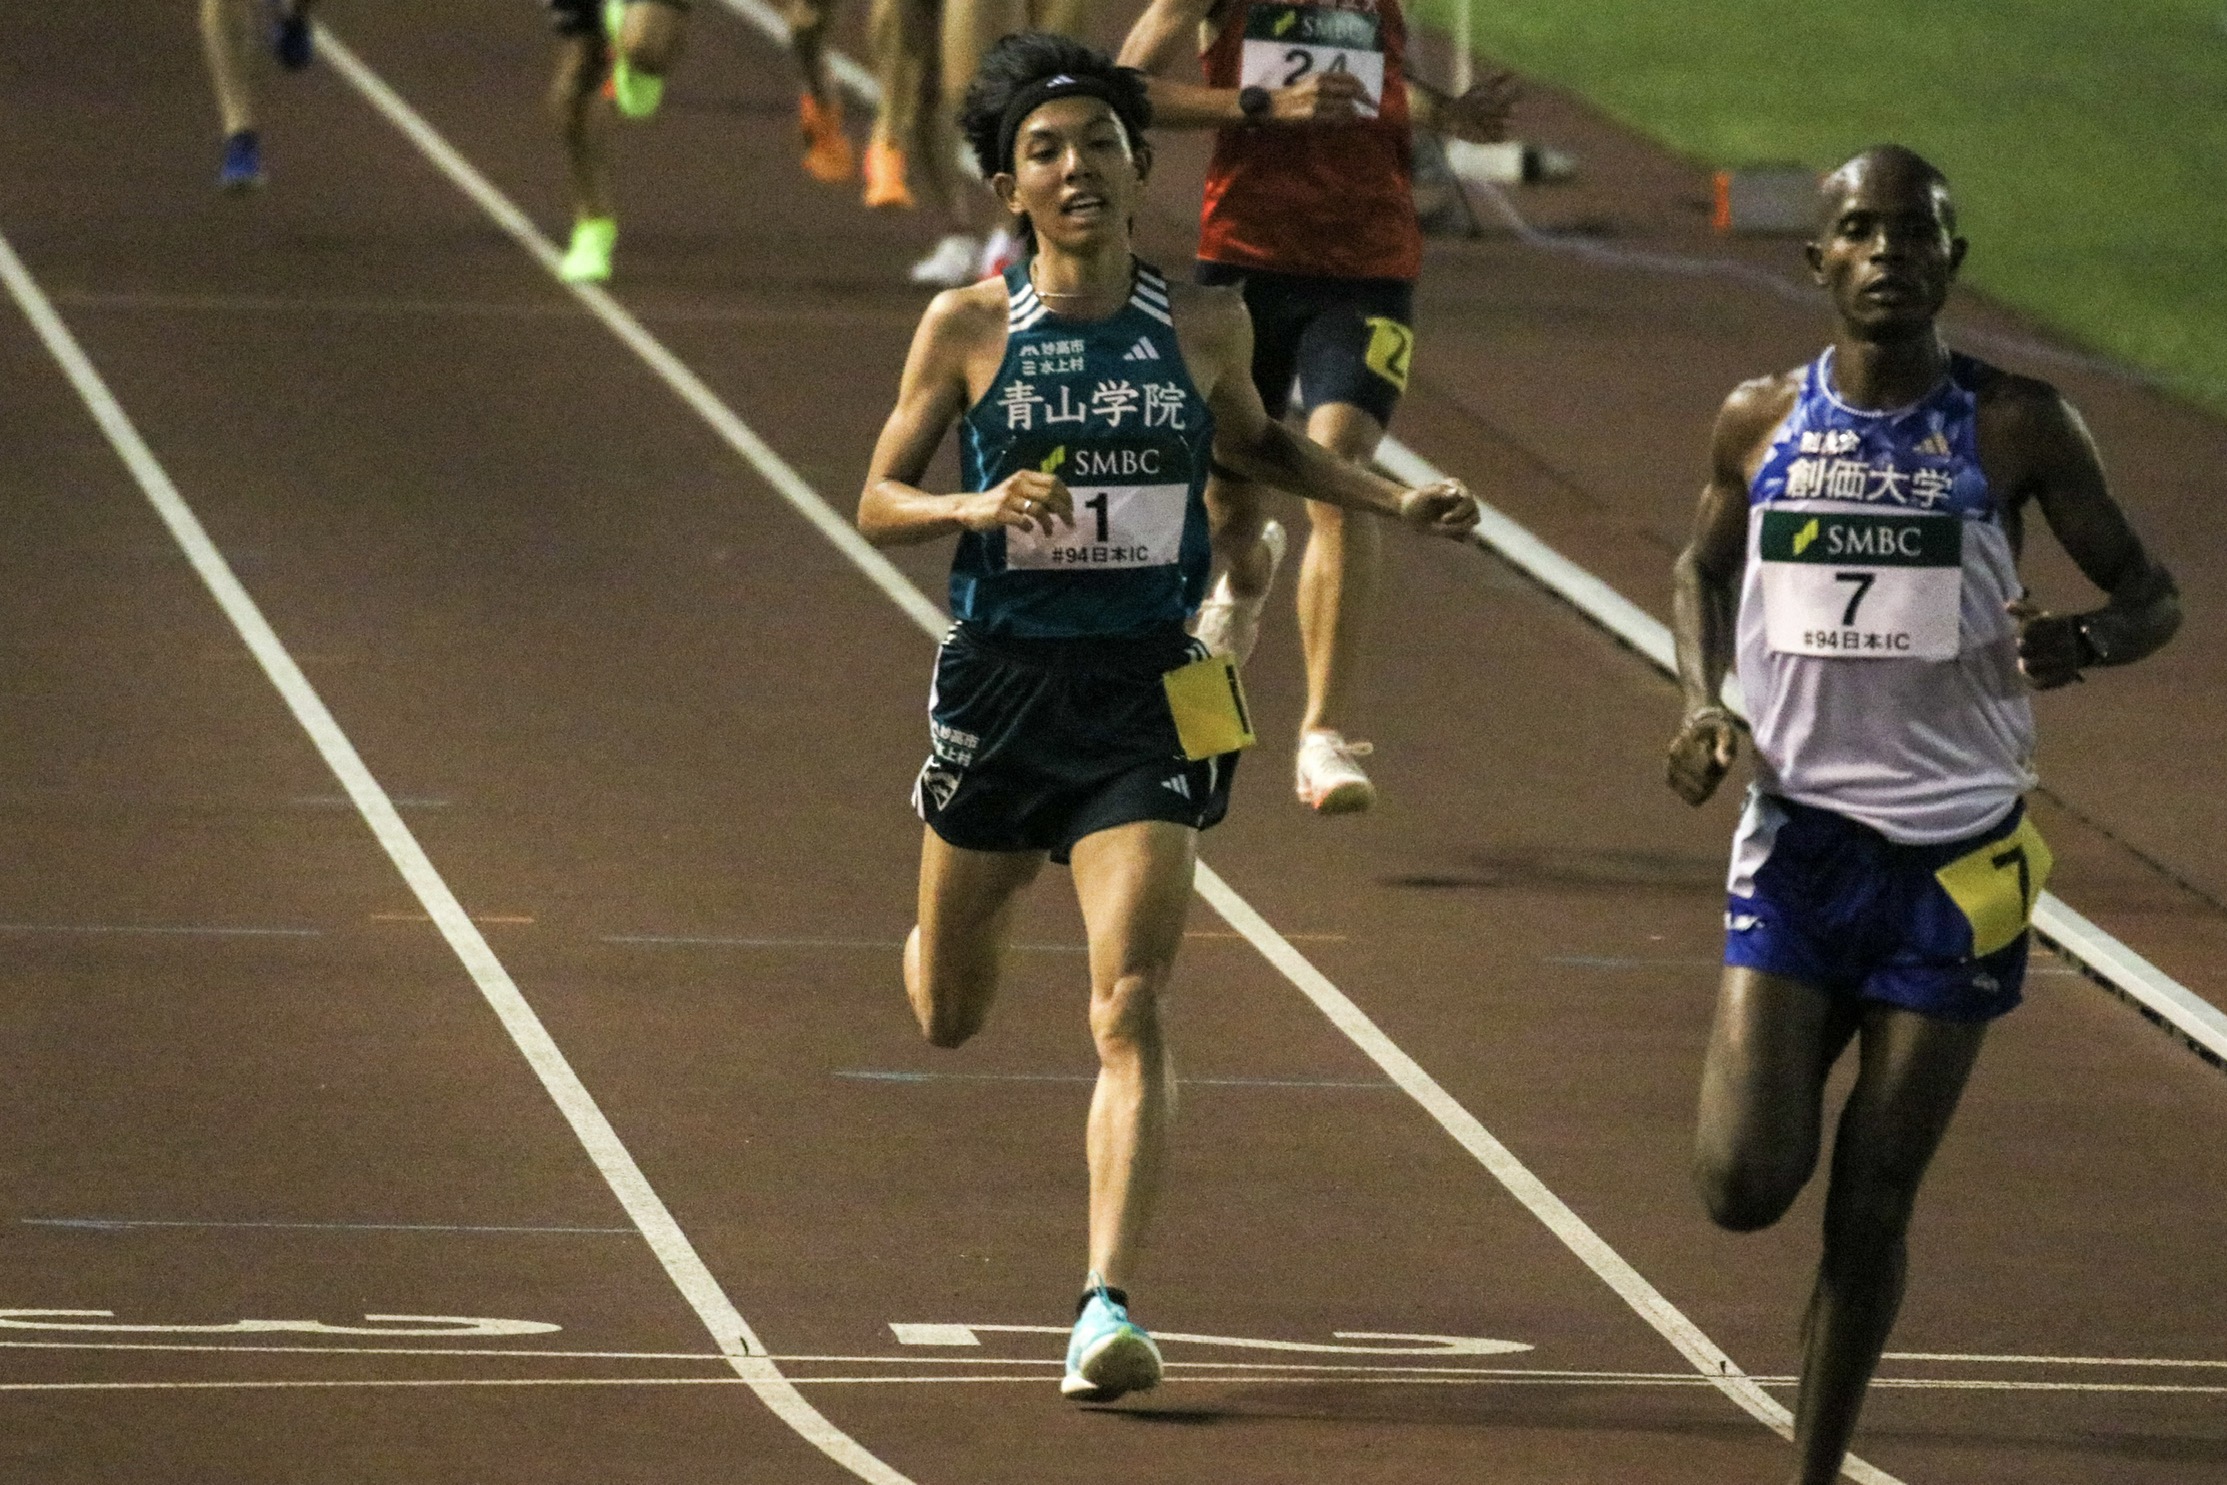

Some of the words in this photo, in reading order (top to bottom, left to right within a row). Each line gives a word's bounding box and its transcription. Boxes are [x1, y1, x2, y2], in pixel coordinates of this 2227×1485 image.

[996, 379, 1187, 431] 青山学院
[1074, 449, 1161, 476] SMBC
[1785, 457, 1953, 509] 創価大学
[1085, 492, 1109, 543] 1
[1827, 523, 1922, 556] SMBC
[1051, 546, 1149, 564] #94日本IC
[1835, 571, 1876, 627] 7
[1803, 630, 1910, 650] #94日本IC
[1991, 843, 2031, 923] 7
